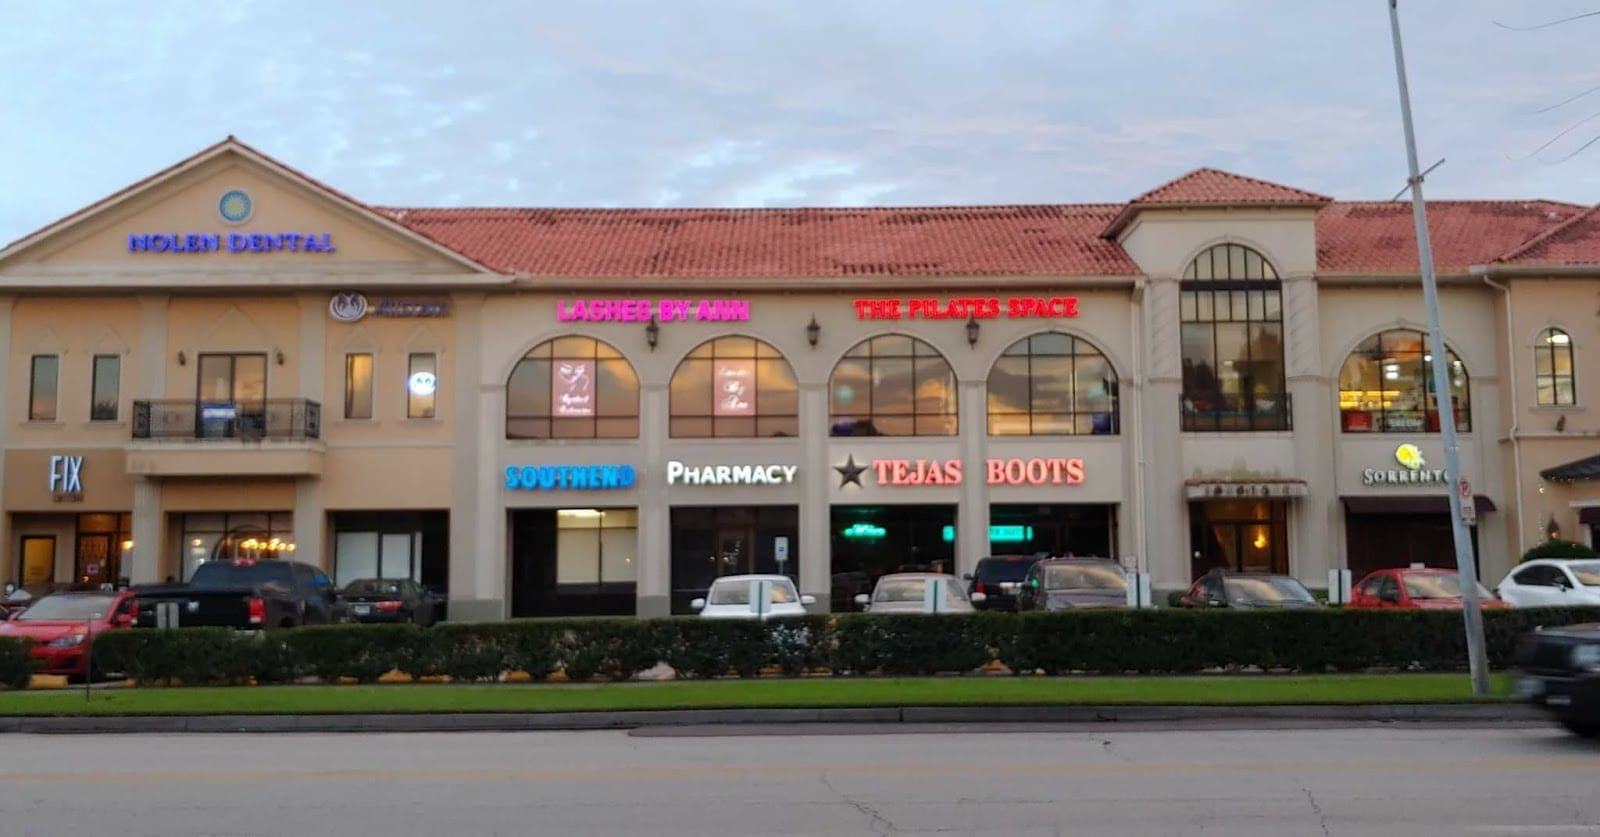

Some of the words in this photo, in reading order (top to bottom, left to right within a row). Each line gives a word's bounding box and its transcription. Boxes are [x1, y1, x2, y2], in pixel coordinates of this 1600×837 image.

[127, 232, 221, 253] NOLEN
[227, 232, 336, 253] DENTAL
[557, 299, 651, 322] LASHES
[658, 299, 692, 322] BY
[695, 299, 750, 322] ANN
[854, 298, 902, 320] THE
[908, 297, 1001, 320] PILATES
[1007, 297, 1079, 319] SPACE
[49, 455, 84, 493] FIX
[505, 463, 636, 490] SOUTHEND
[667, 460, 797, 486] PHARMACY
[872, 458, 963, 486] TEJAS
[986, 458, 1085, 486] BOOTS
